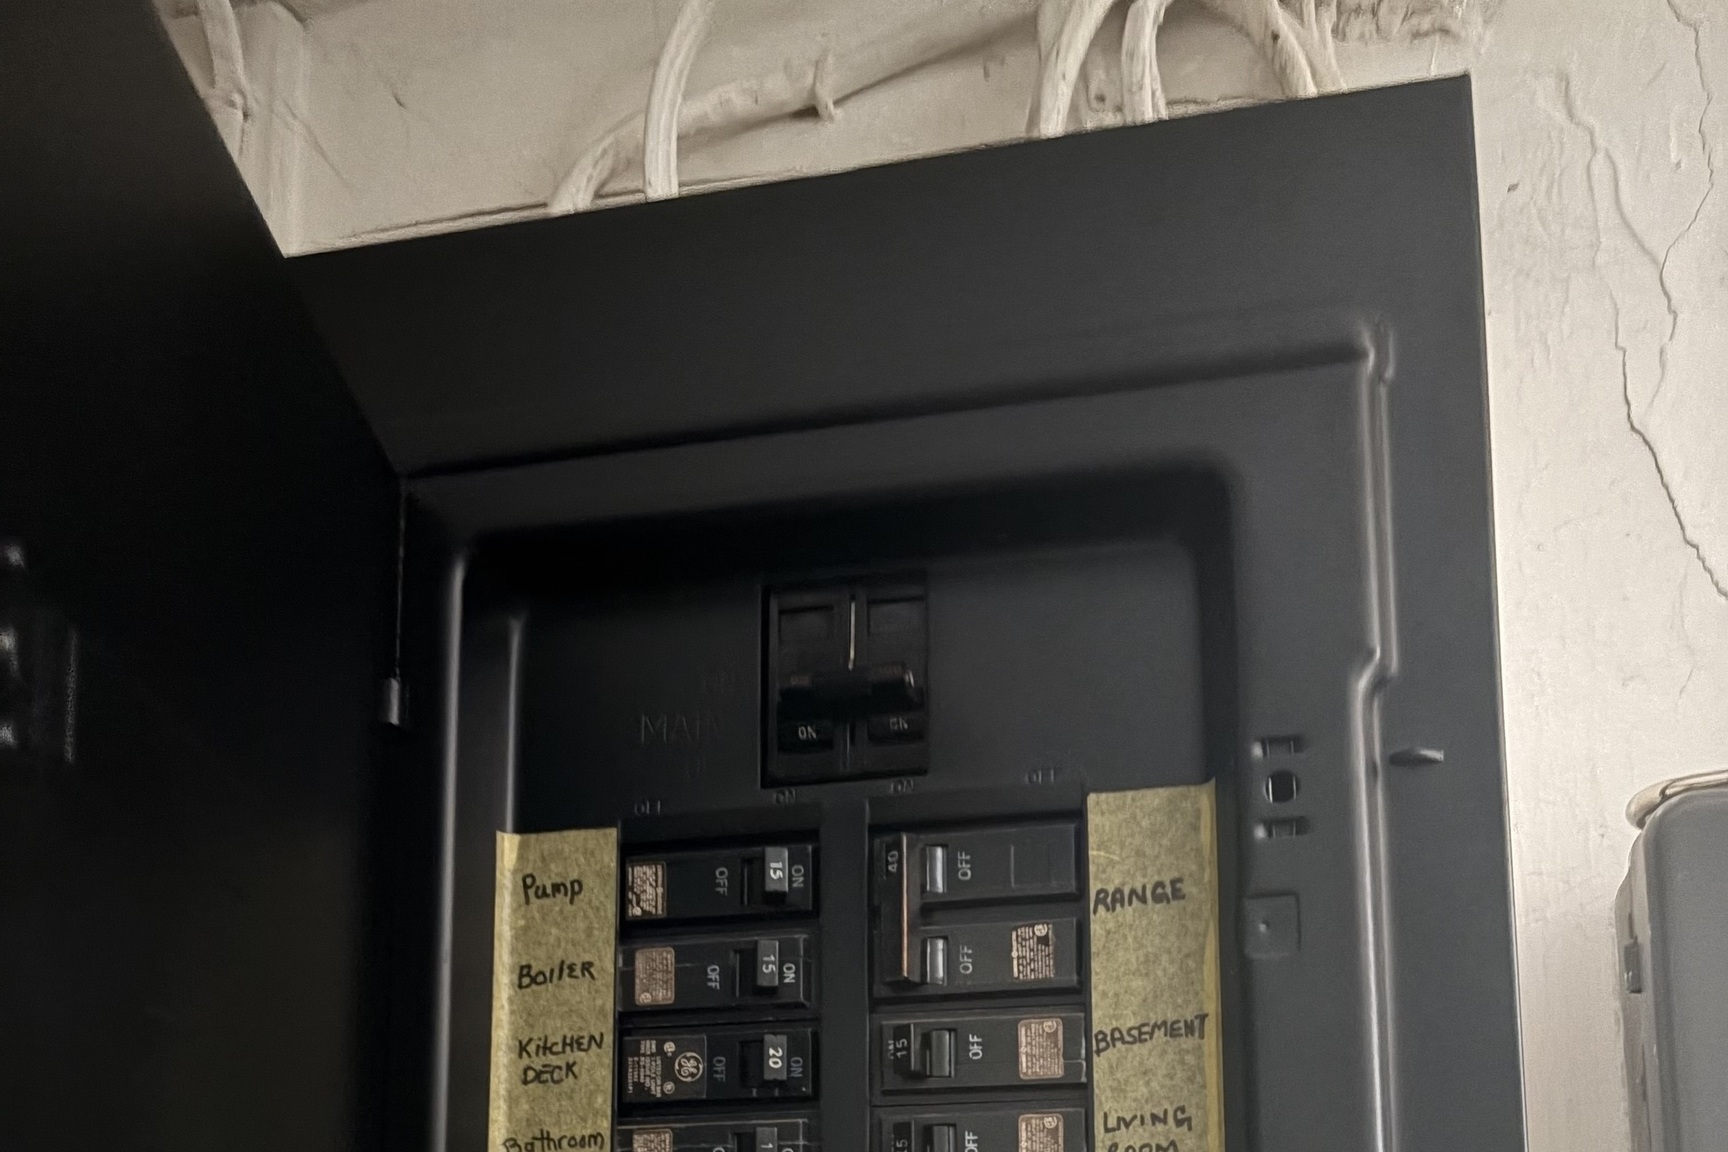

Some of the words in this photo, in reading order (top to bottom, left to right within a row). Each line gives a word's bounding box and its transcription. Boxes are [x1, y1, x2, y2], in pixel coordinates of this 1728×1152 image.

[798, 725, 817, 741] ON
[769, 862, 783, 880] 15
[887, 851, 899, 873] 40
[958, 851, 972, 880] OFF
[715, 867, 728, 896] OFF
[791, 865, 804, 888] ON
[521, 873, 583, 905] Pump
[1092, 877, 1187, 916] RANGE
[762, 954, 776, 973] 15
[960, 944, 974, 974] OFF
[707, 965, 720, 990] OFF
[783, 963, 796, 983] ON
[969, 1033, 983, 1060] OFF
[1093, 1013, 1209, 1057] BASEMENT
[768, 1047, 783, 1068] 20
[896, 1038, 908, 1059] 15
[522, 1061, 579, 1085] DECK
[713, 1056, 726, 1082] OFF
[790, 1057, 803, 1078] ON
